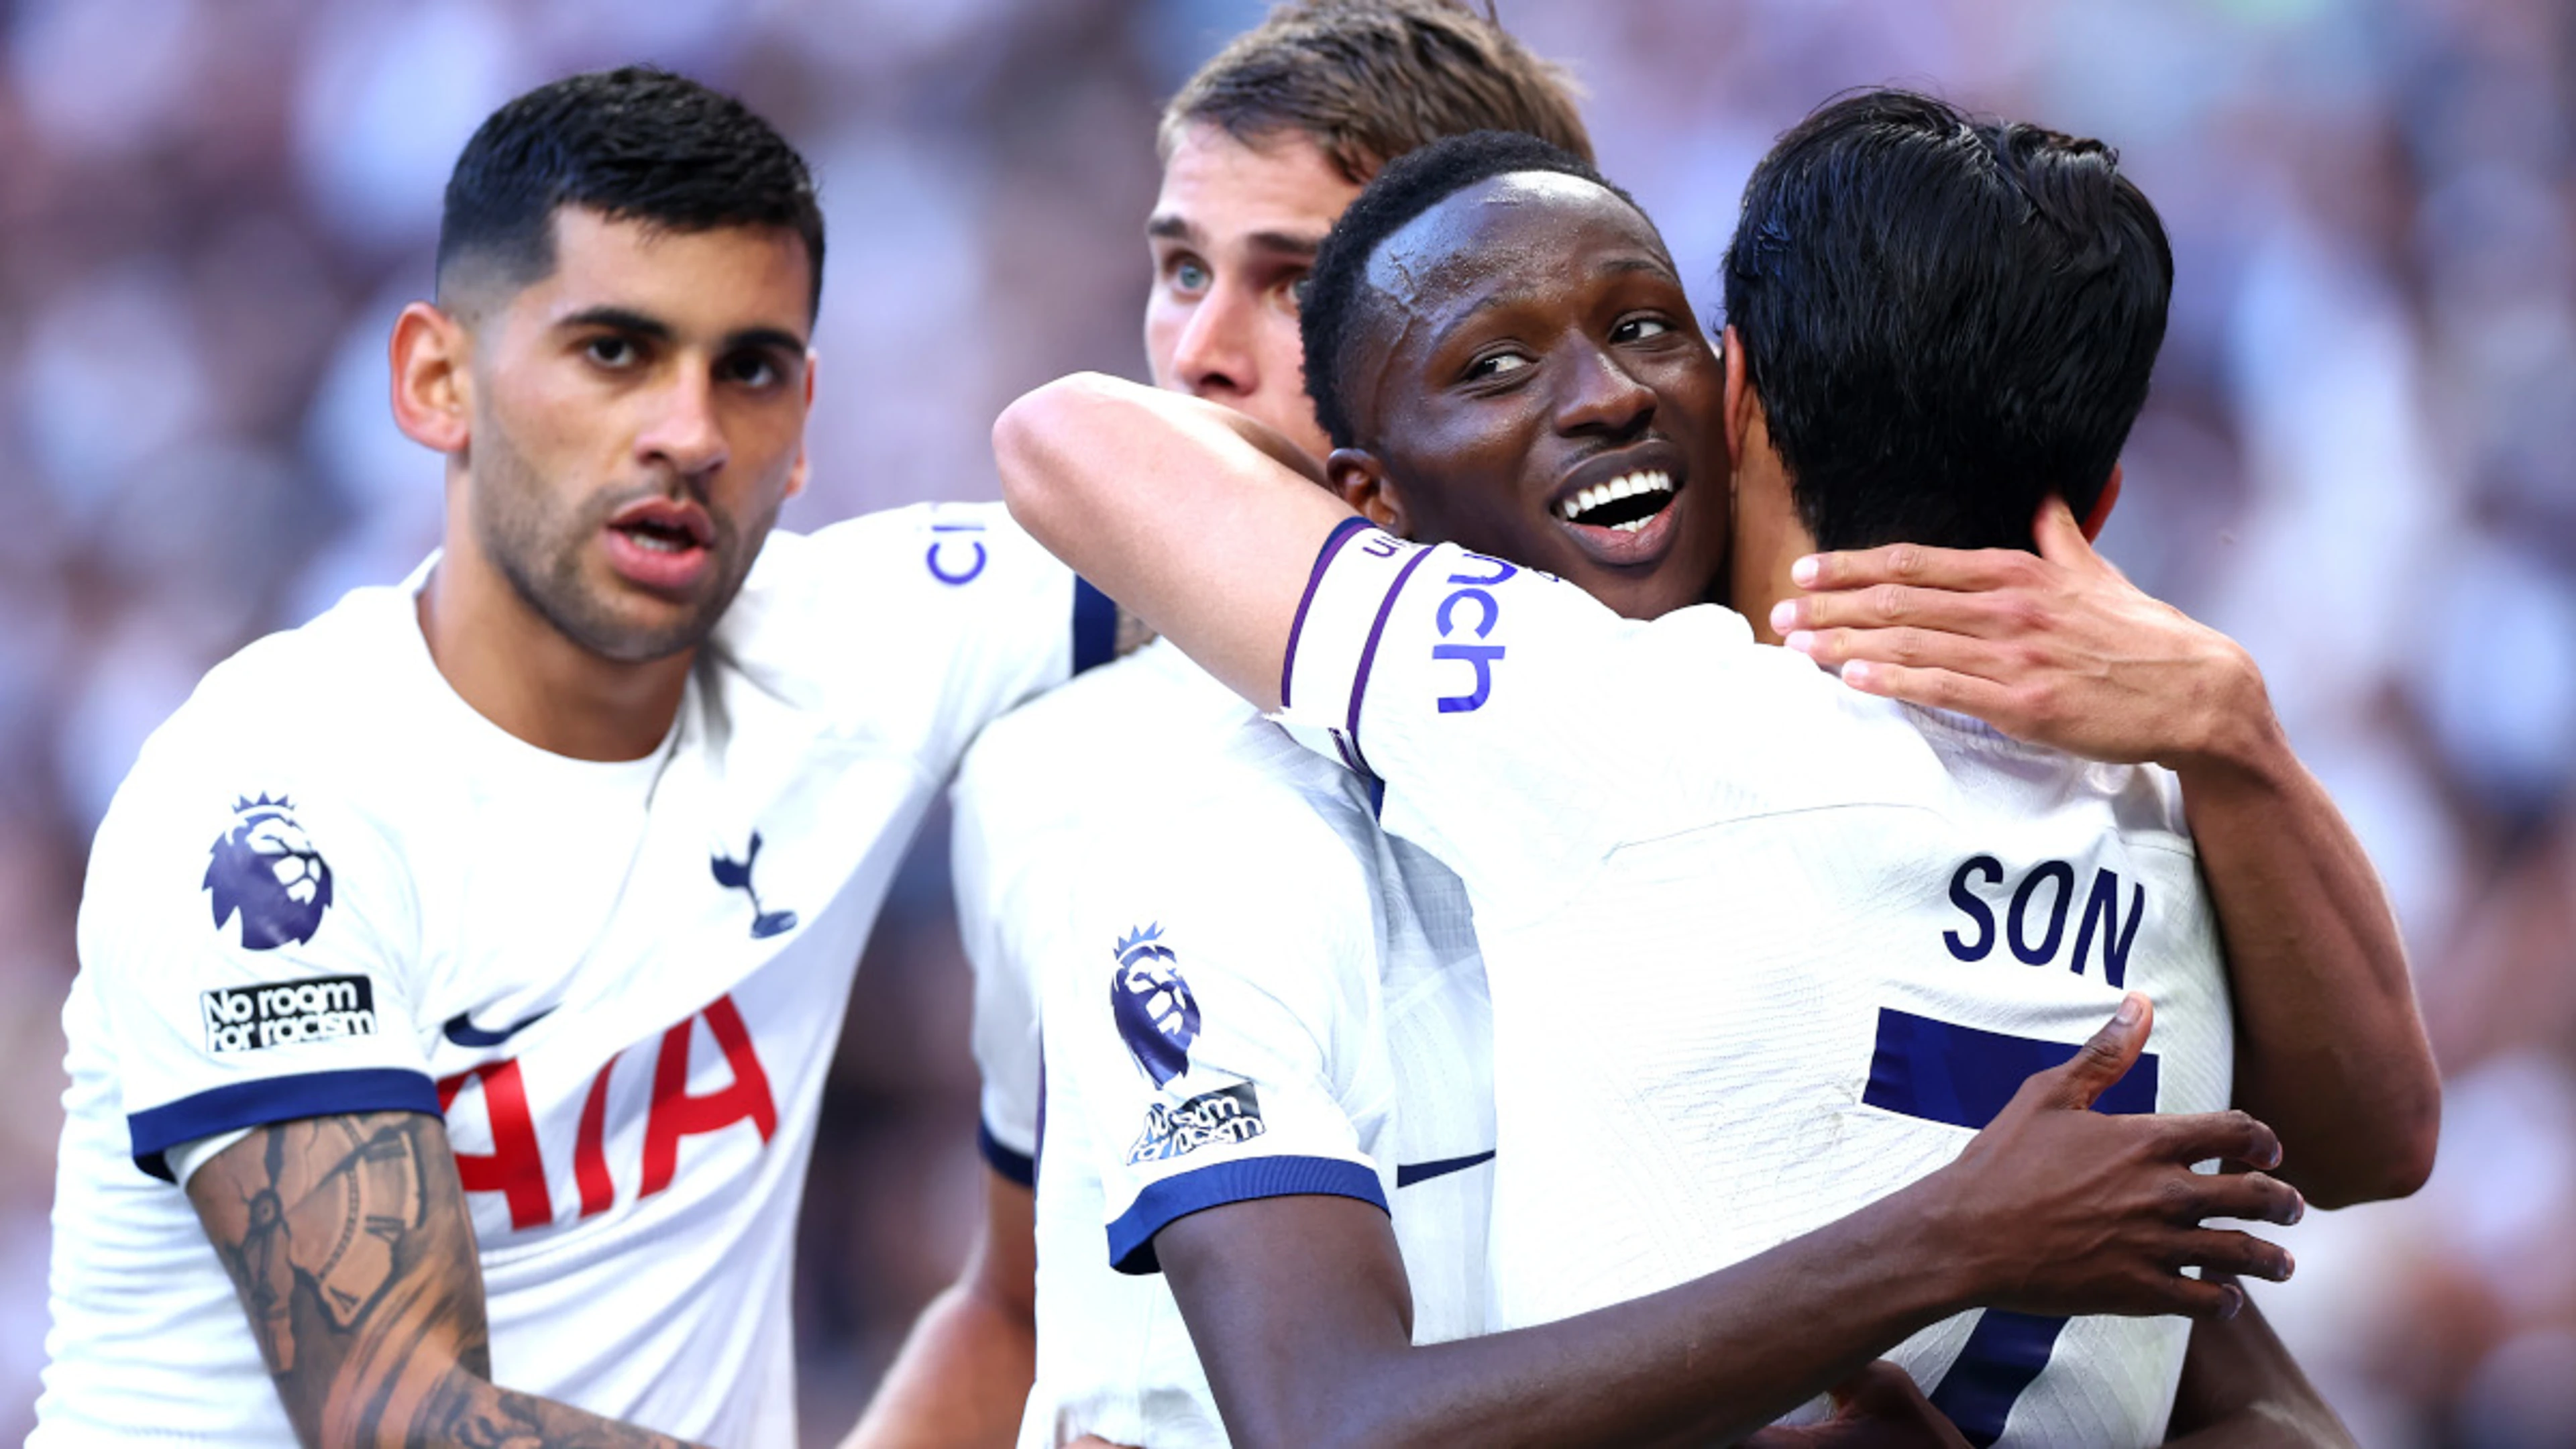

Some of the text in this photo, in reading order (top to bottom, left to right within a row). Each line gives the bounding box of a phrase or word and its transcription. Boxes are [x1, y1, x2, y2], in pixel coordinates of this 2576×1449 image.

[1432, 552, 1519, 714] nch
[1942, 855, 2145, 989] SON
[201, 981, 358, 1025] No room
[207, 1010, 378, 1052] for racism
[436, 993, 778, 1231] AIA
[1861, 1006, 2159, 1449] 7
